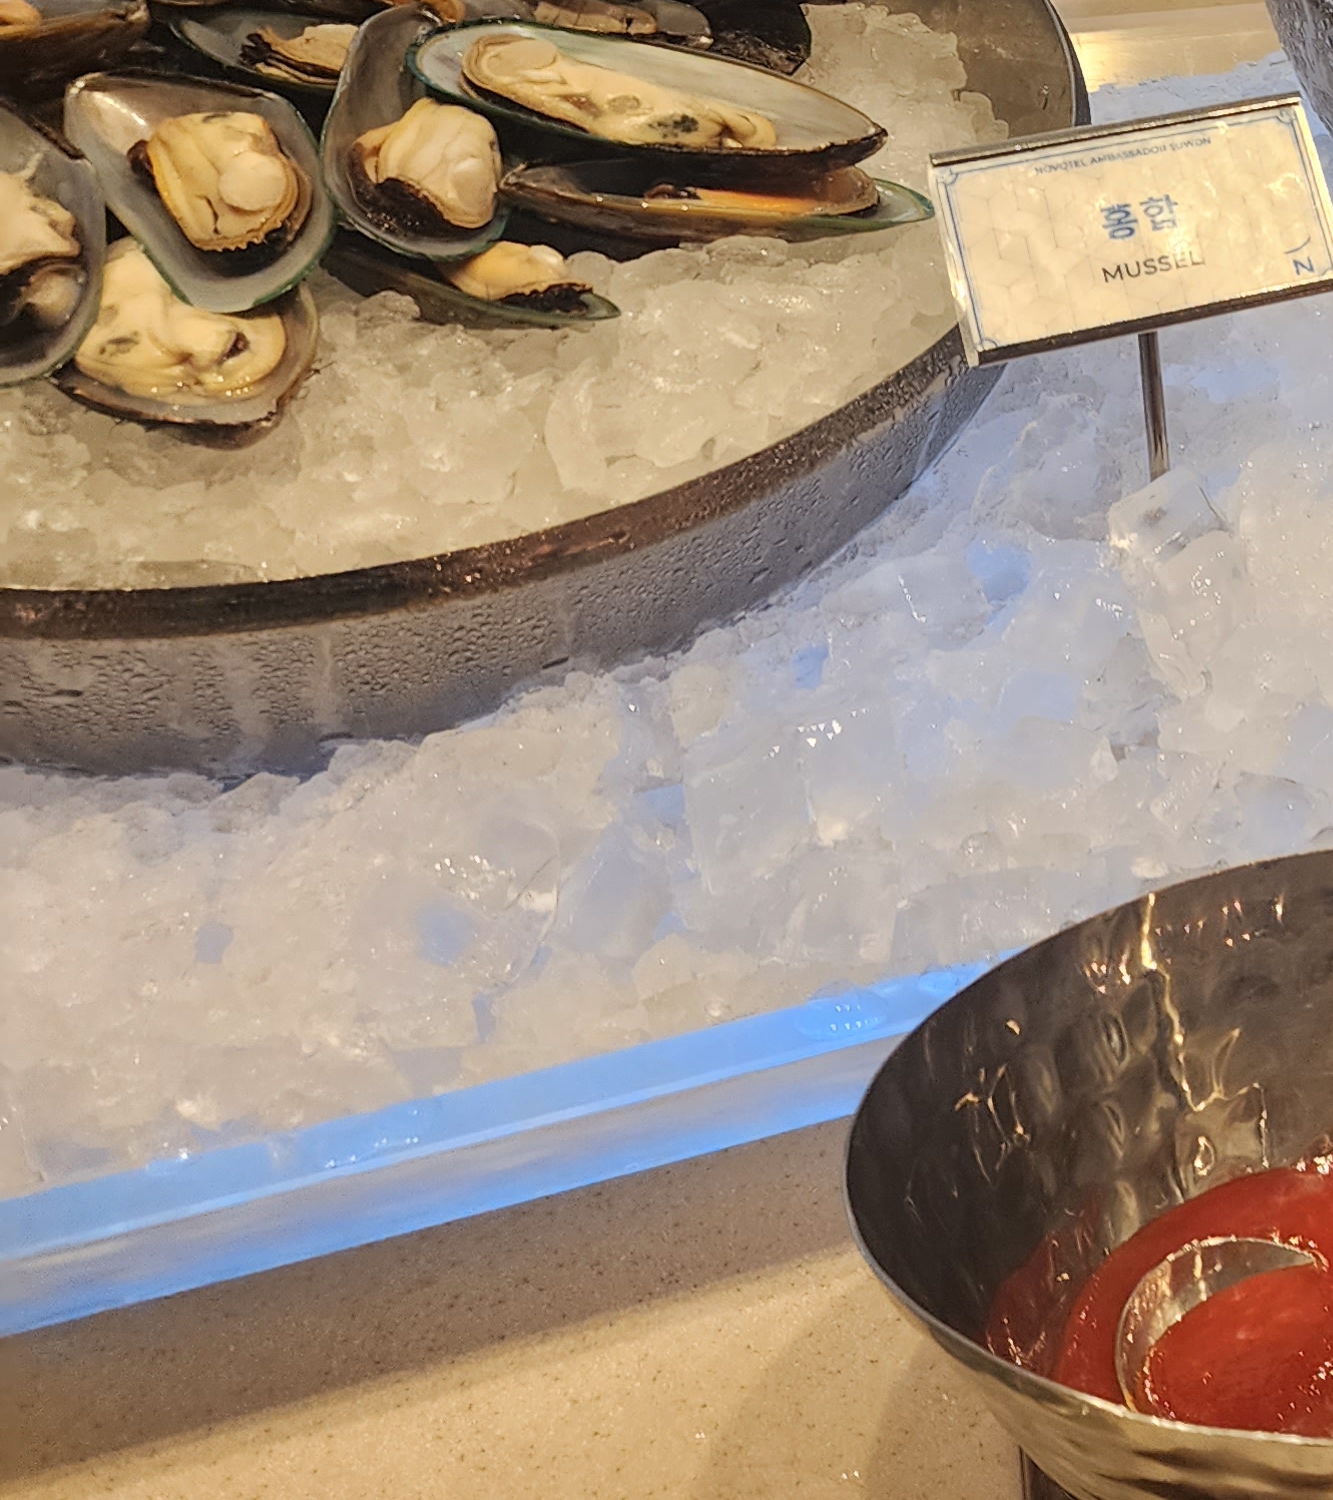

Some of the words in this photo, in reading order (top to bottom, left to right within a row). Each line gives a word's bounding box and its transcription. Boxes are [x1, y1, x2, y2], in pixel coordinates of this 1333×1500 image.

[1034, 158, 1087, 176] NOVOTEL
[1101, 194, 1179, 241] 홍합
[1102, 248, 1205, 284] MUSSEL
